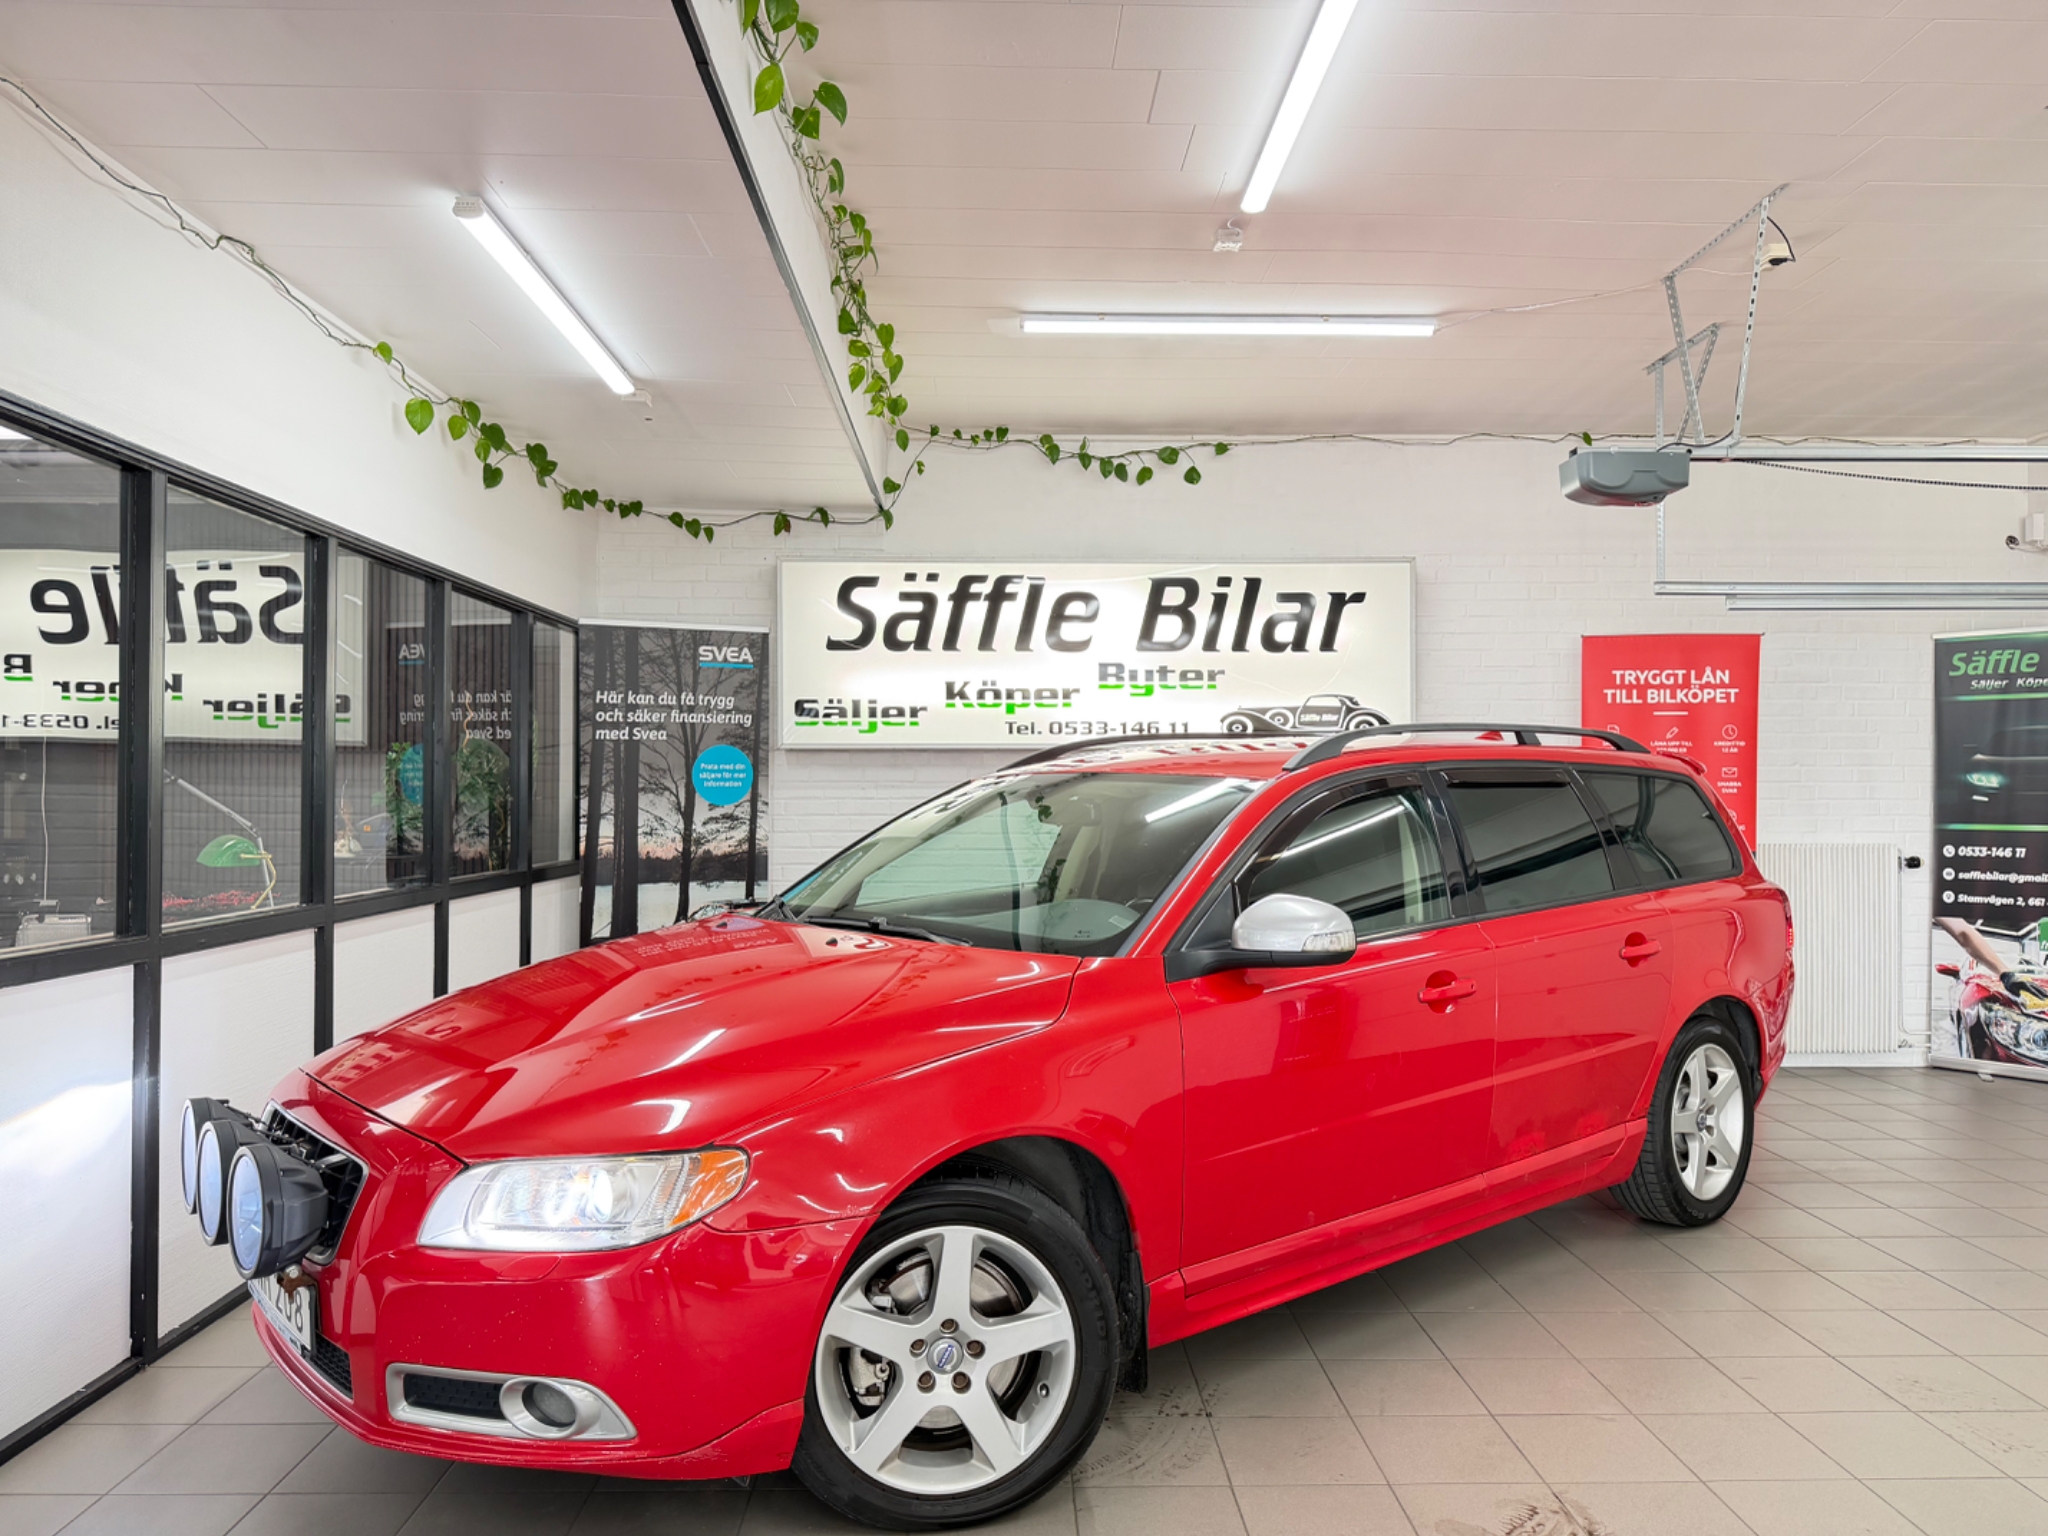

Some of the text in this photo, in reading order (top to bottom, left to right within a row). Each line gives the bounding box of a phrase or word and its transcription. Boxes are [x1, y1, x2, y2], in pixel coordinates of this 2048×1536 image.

[826, 572, 1367, 652] Säffle Bilar
[699, 646, 753, 662] SVEA
[1948, 649, 2040, 676] Säffle
[1098, 662, 1225, 697] Byter
[1612, 666, 1730, 685] TRYGGT LÅN
[596, 690, 735, 709] Här kan du få trygg
[945, 680, 1080, 715] Köper
[1603, 685, 1739, 704] TILL BILKÖPET
[595, 708, 753, 727] och säker finansiering
[794, 698, 928, 734] Säljer
[595, 727, 667, 740] med Svea
[1005, 721, 1189, 735] Tel. 0533-146 11
[1958, 846, 2027, 859] 0533-146 11
[1957, 893, 2015, 907] Stamvägen
